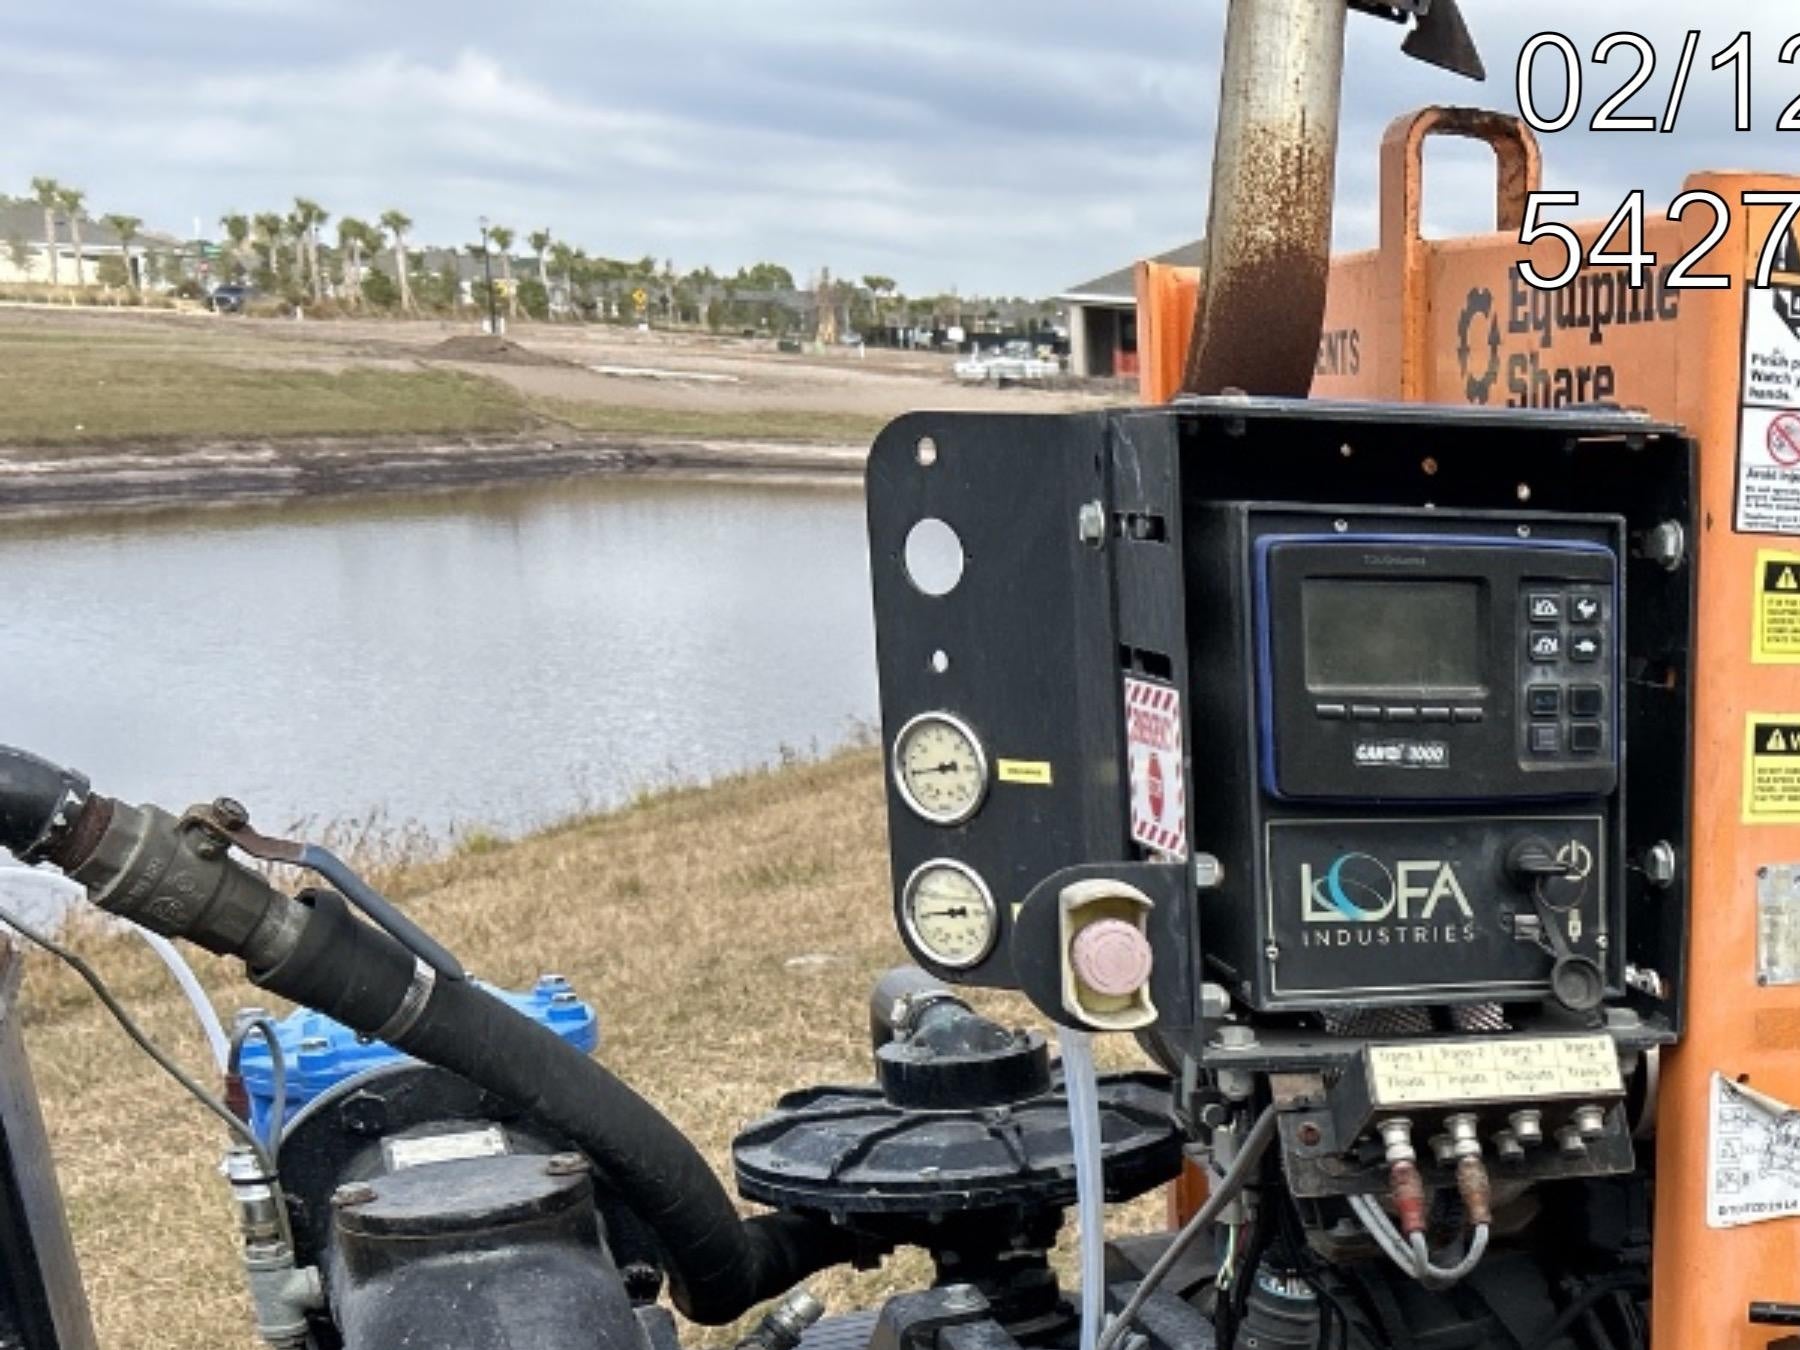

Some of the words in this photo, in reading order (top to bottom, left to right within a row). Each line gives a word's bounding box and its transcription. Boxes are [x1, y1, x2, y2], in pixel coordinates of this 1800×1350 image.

[1507, 352, 1615, 409] Share
[1301, 852, 1475, 922] LOFA
[1301, 920, 1476, 948] INDUSTRIES
